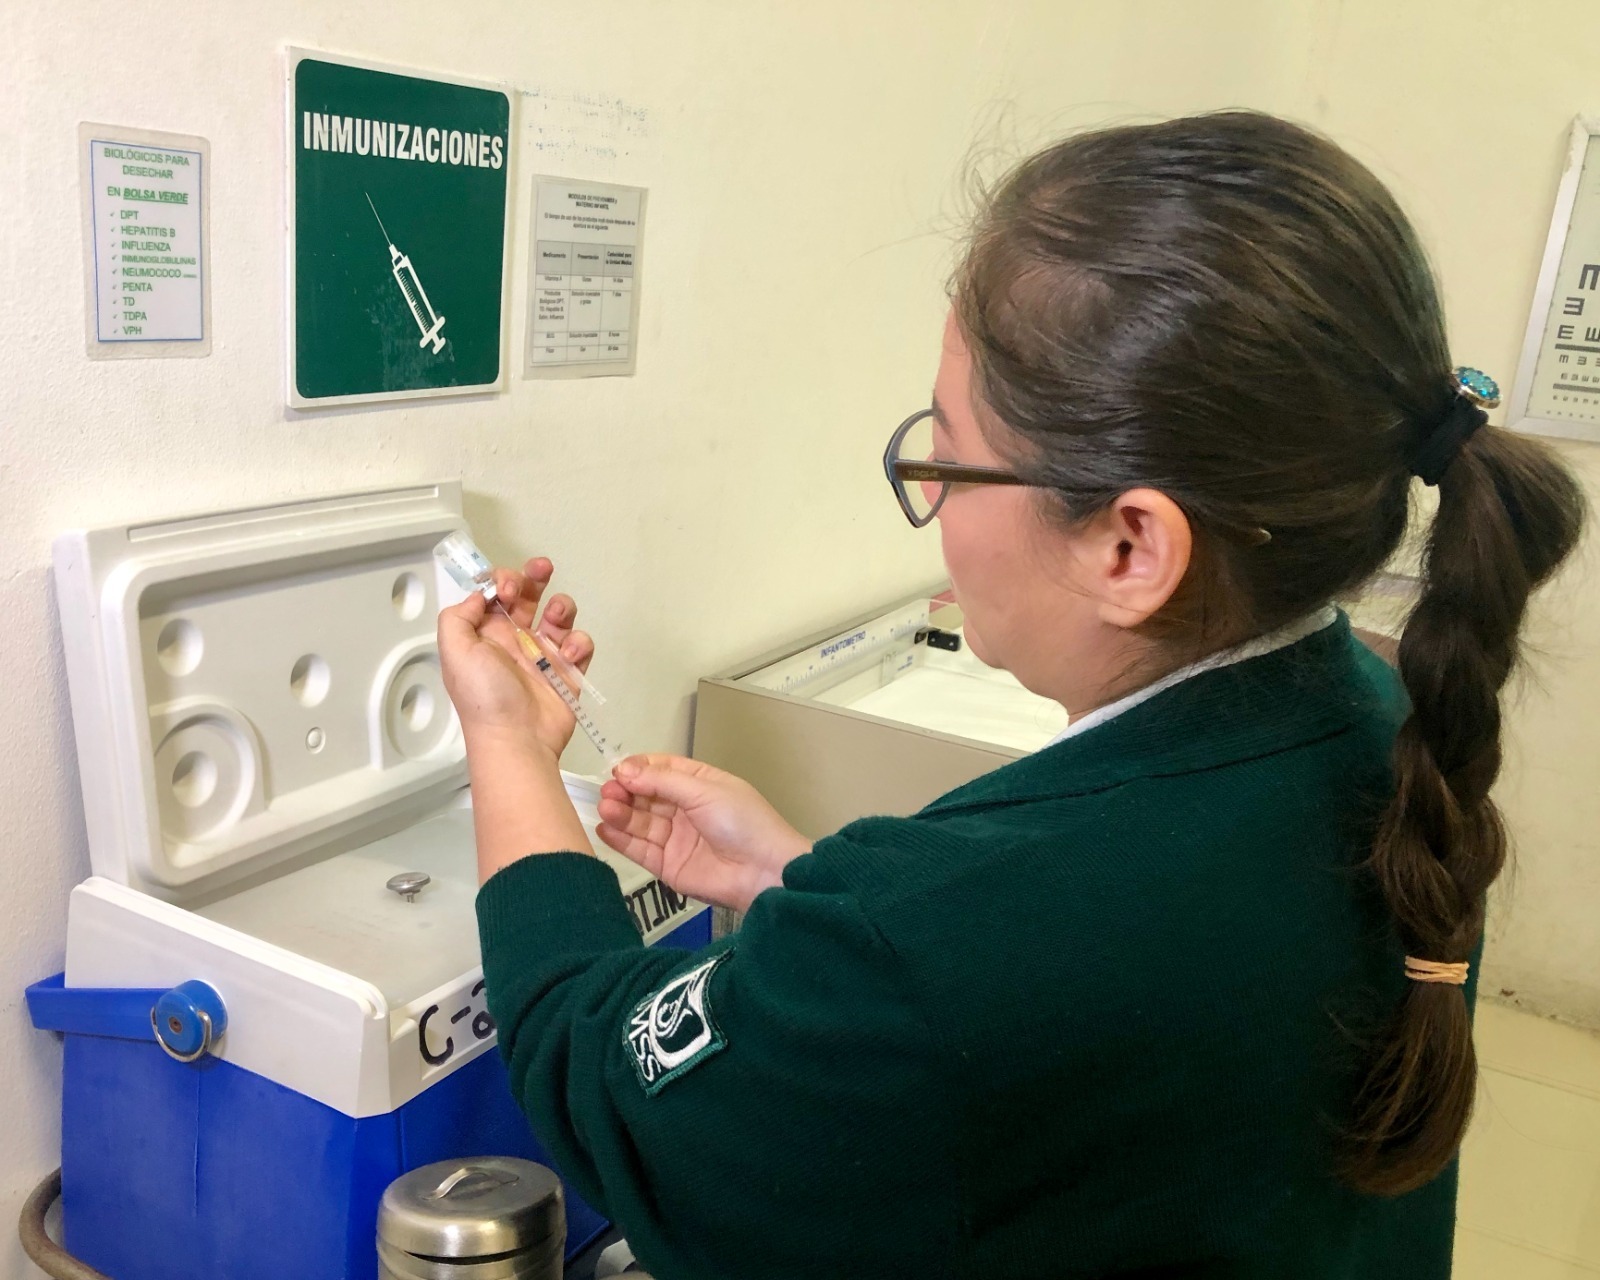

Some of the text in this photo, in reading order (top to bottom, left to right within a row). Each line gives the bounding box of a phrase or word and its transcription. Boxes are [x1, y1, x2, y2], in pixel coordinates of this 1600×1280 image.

[303, 111, 504, 169] INMUNIZACIONES
[104, 148, 190, 166] BIOLÓGICOS PARA
[122, 165, 173, 179] DESECHAR
[107, 186, 189, 203] EN BOLSA VERDE
[120, 210, 139, 220] DPT
[121, 226, 176, 238] HEPATITIS B
[121, 240, 172, 252] INFLUENZA
[122, 268, 181, 278] NEUMOCOCO
[122, 282, 153, 292] PENTA
[123, 296, 135, 306] TD
[123, 311, 147, 321] TDPA
[122, 325, 142, 335] VPH
[820, 631, 866, 658] INFANTOMETRO
